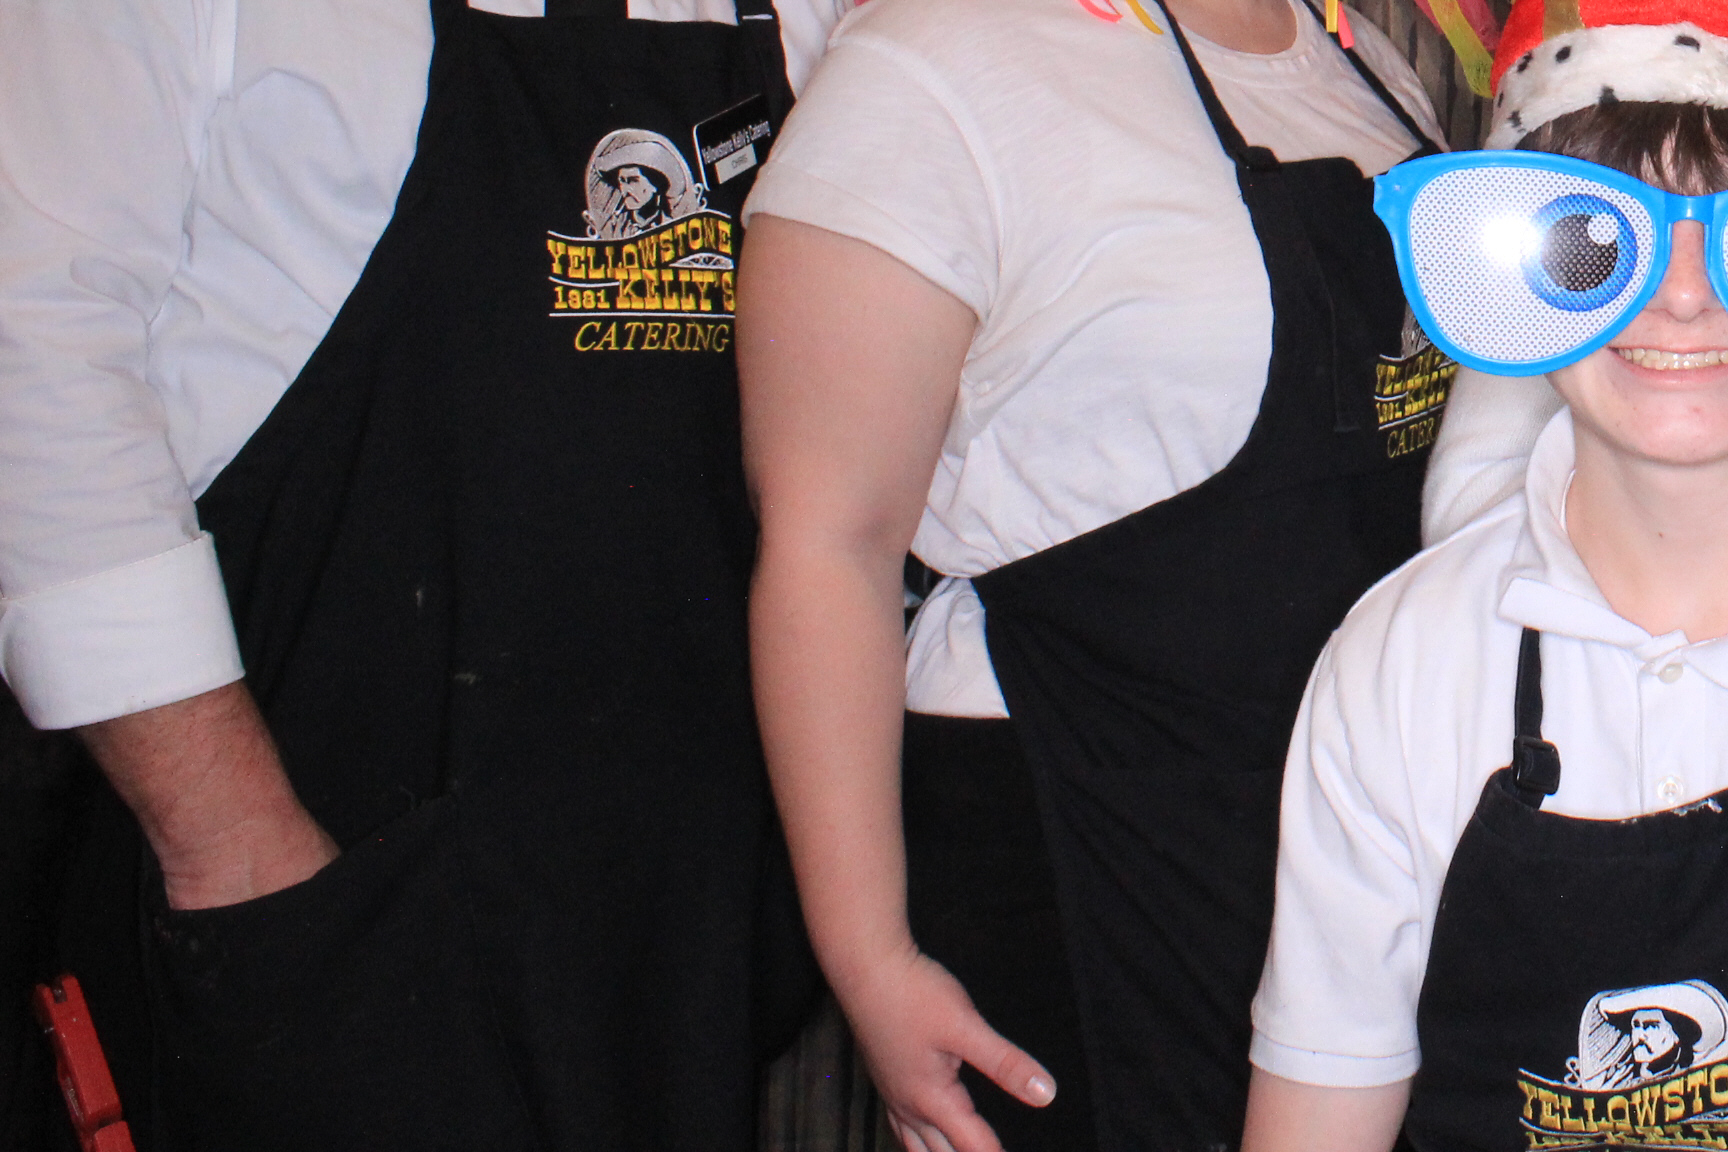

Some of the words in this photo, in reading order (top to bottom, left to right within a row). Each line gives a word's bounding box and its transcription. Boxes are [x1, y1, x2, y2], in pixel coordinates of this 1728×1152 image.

[546, 218, 733, 279] YELLOWSTONE
[614, 268, 736, 312] KELLY'S
[574, 321, 730, 352] CATERING
[1387, 414, 1441, 459] CATER
